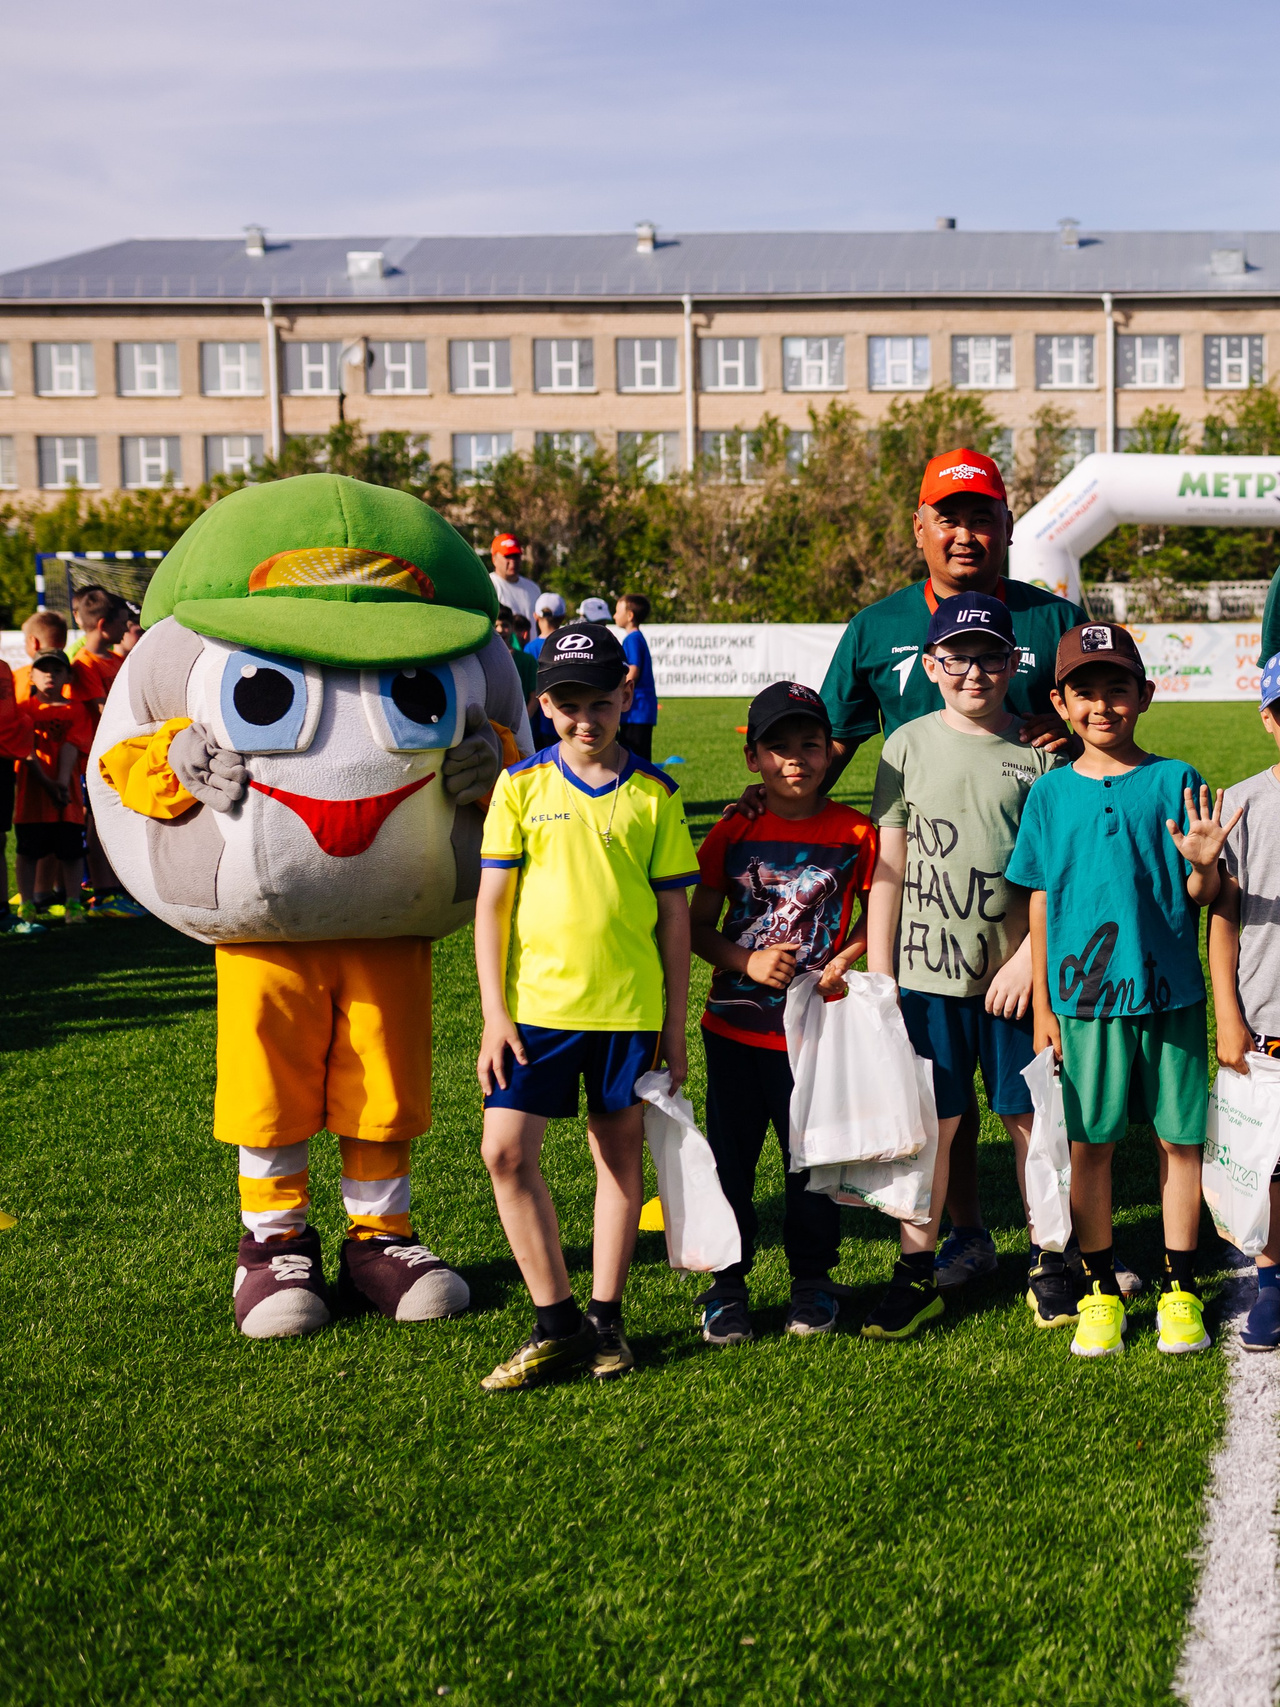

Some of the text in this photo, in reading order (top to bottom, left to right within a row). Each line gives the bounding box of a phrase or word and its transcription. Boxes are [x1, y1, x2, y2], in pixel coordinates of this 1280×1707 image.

[957, 609, 991, 623] UFC
[650, 635, 756, 649] ПРИ ПОДДЕРЖКЕ
[554, 652, 593, 661] HYUNDAI
[742, 672, 796, 684] ОБЛАСТИ
[1002, 762, 1037, 774] CHILLING
[531, 812, 571, 823] KELME
[905, 860, 1006, 923] HAVE
[904, 920, 988, 980] FUN
